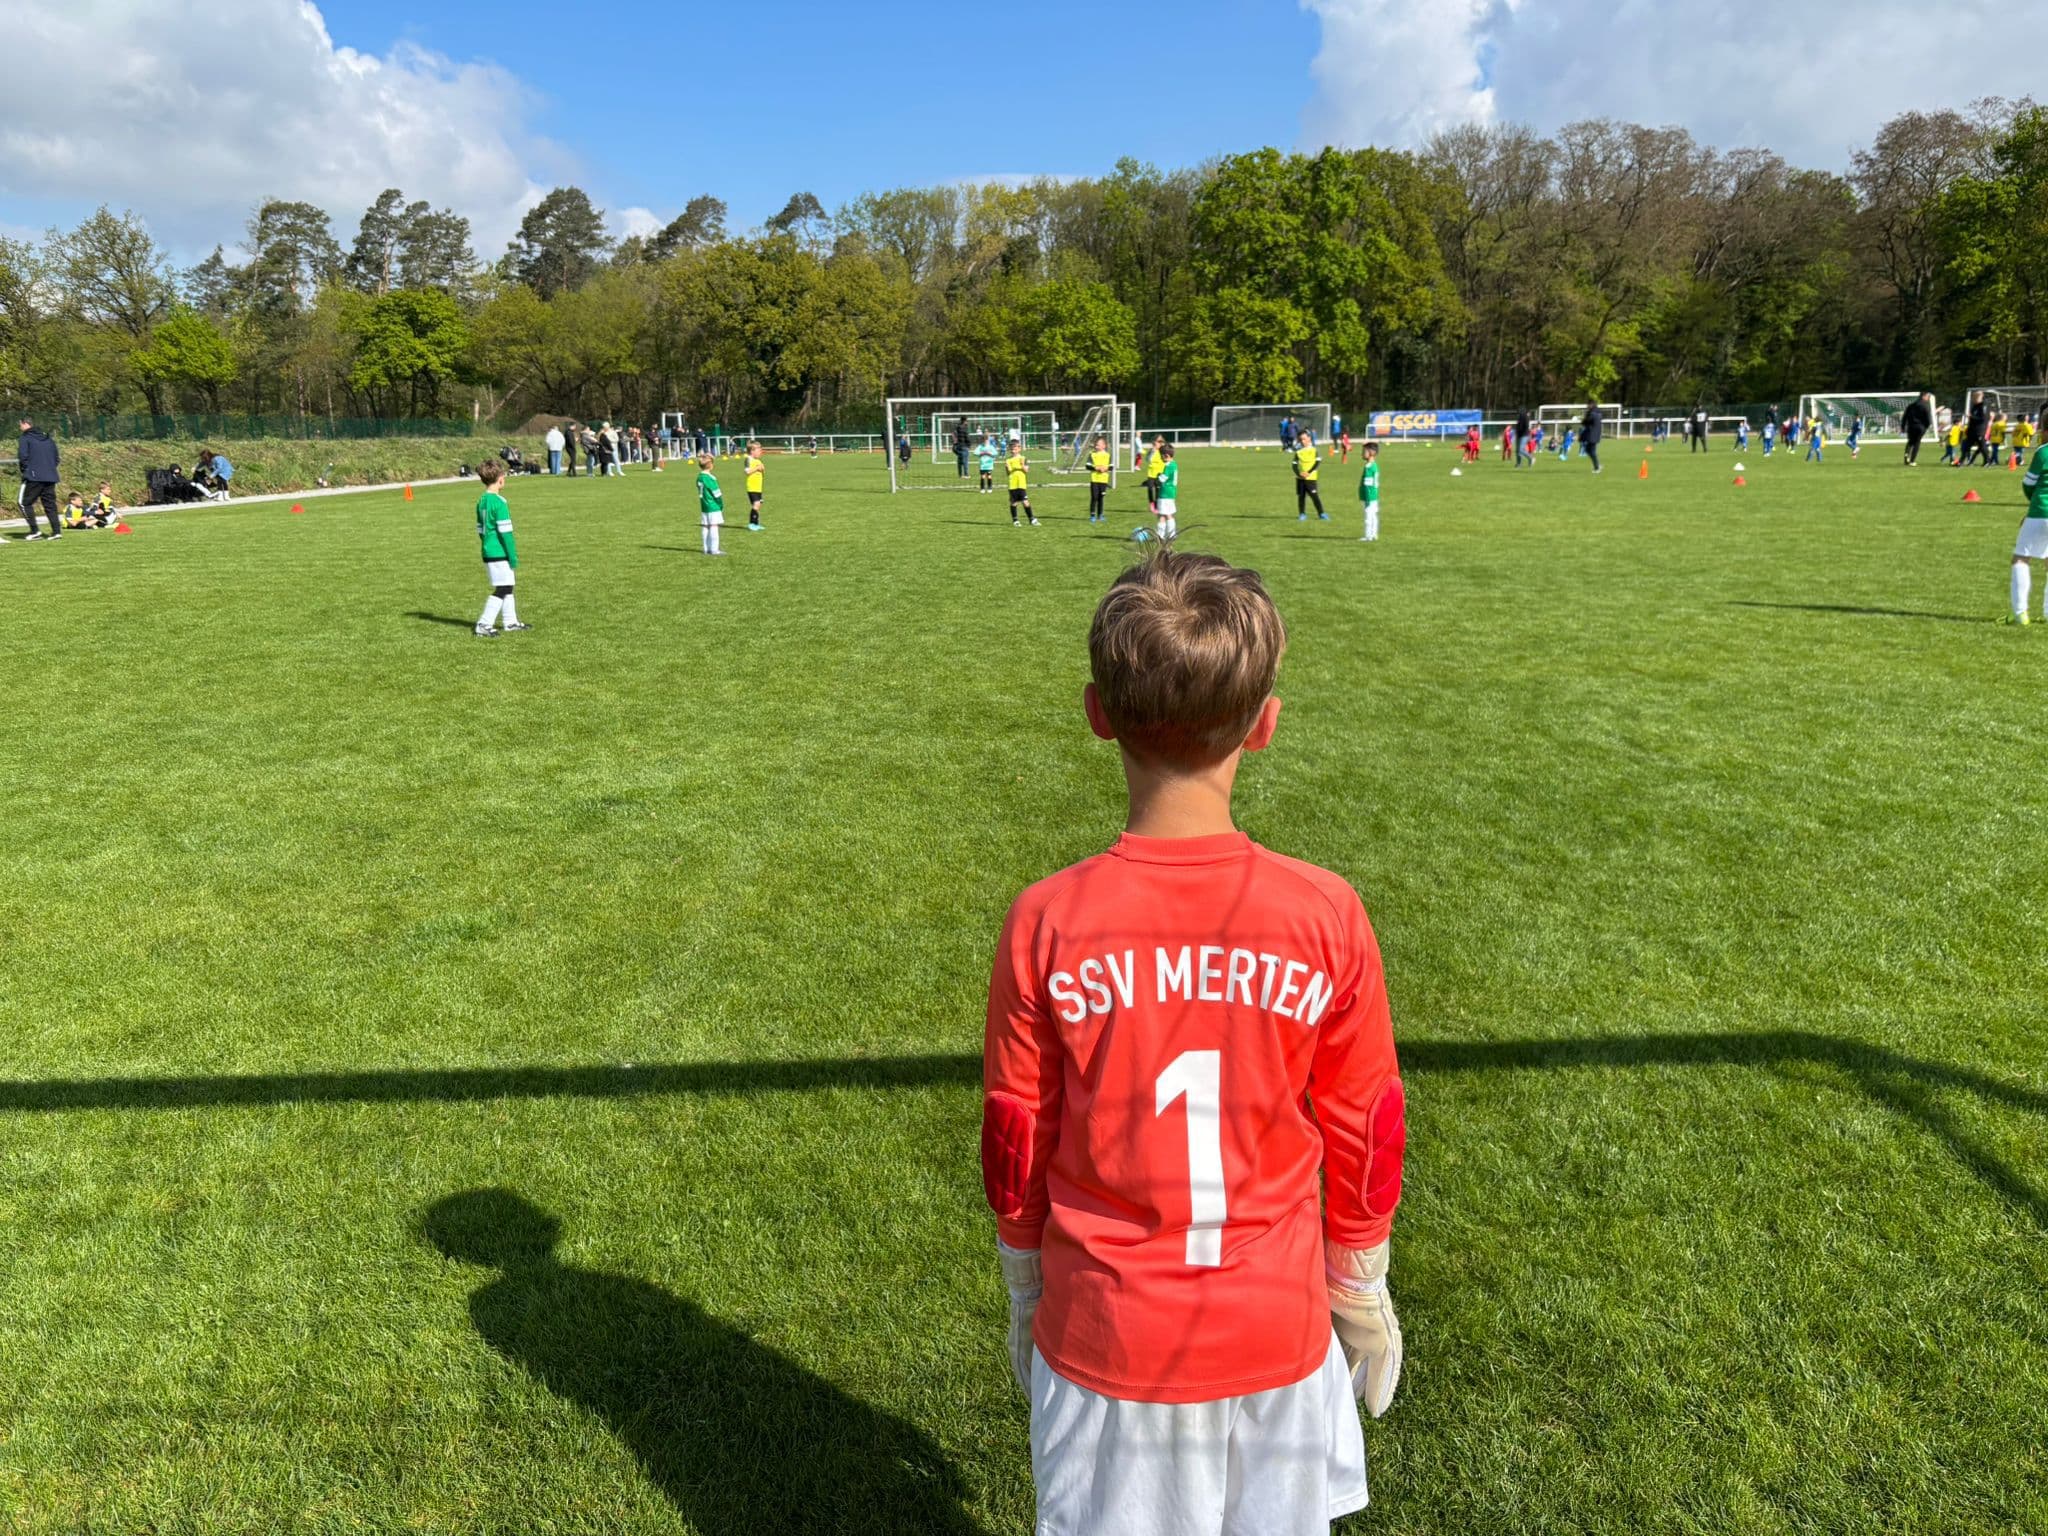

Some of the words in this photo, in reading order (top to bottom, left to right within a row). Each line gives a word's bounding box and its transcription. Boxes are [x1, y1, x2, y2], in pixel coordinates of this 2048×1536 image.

[1049, 949, 1134, 1024] SSV
[1155, 945, 1333, 1026] MERTEN
[1155, 1049, 1227, 1267] 1
